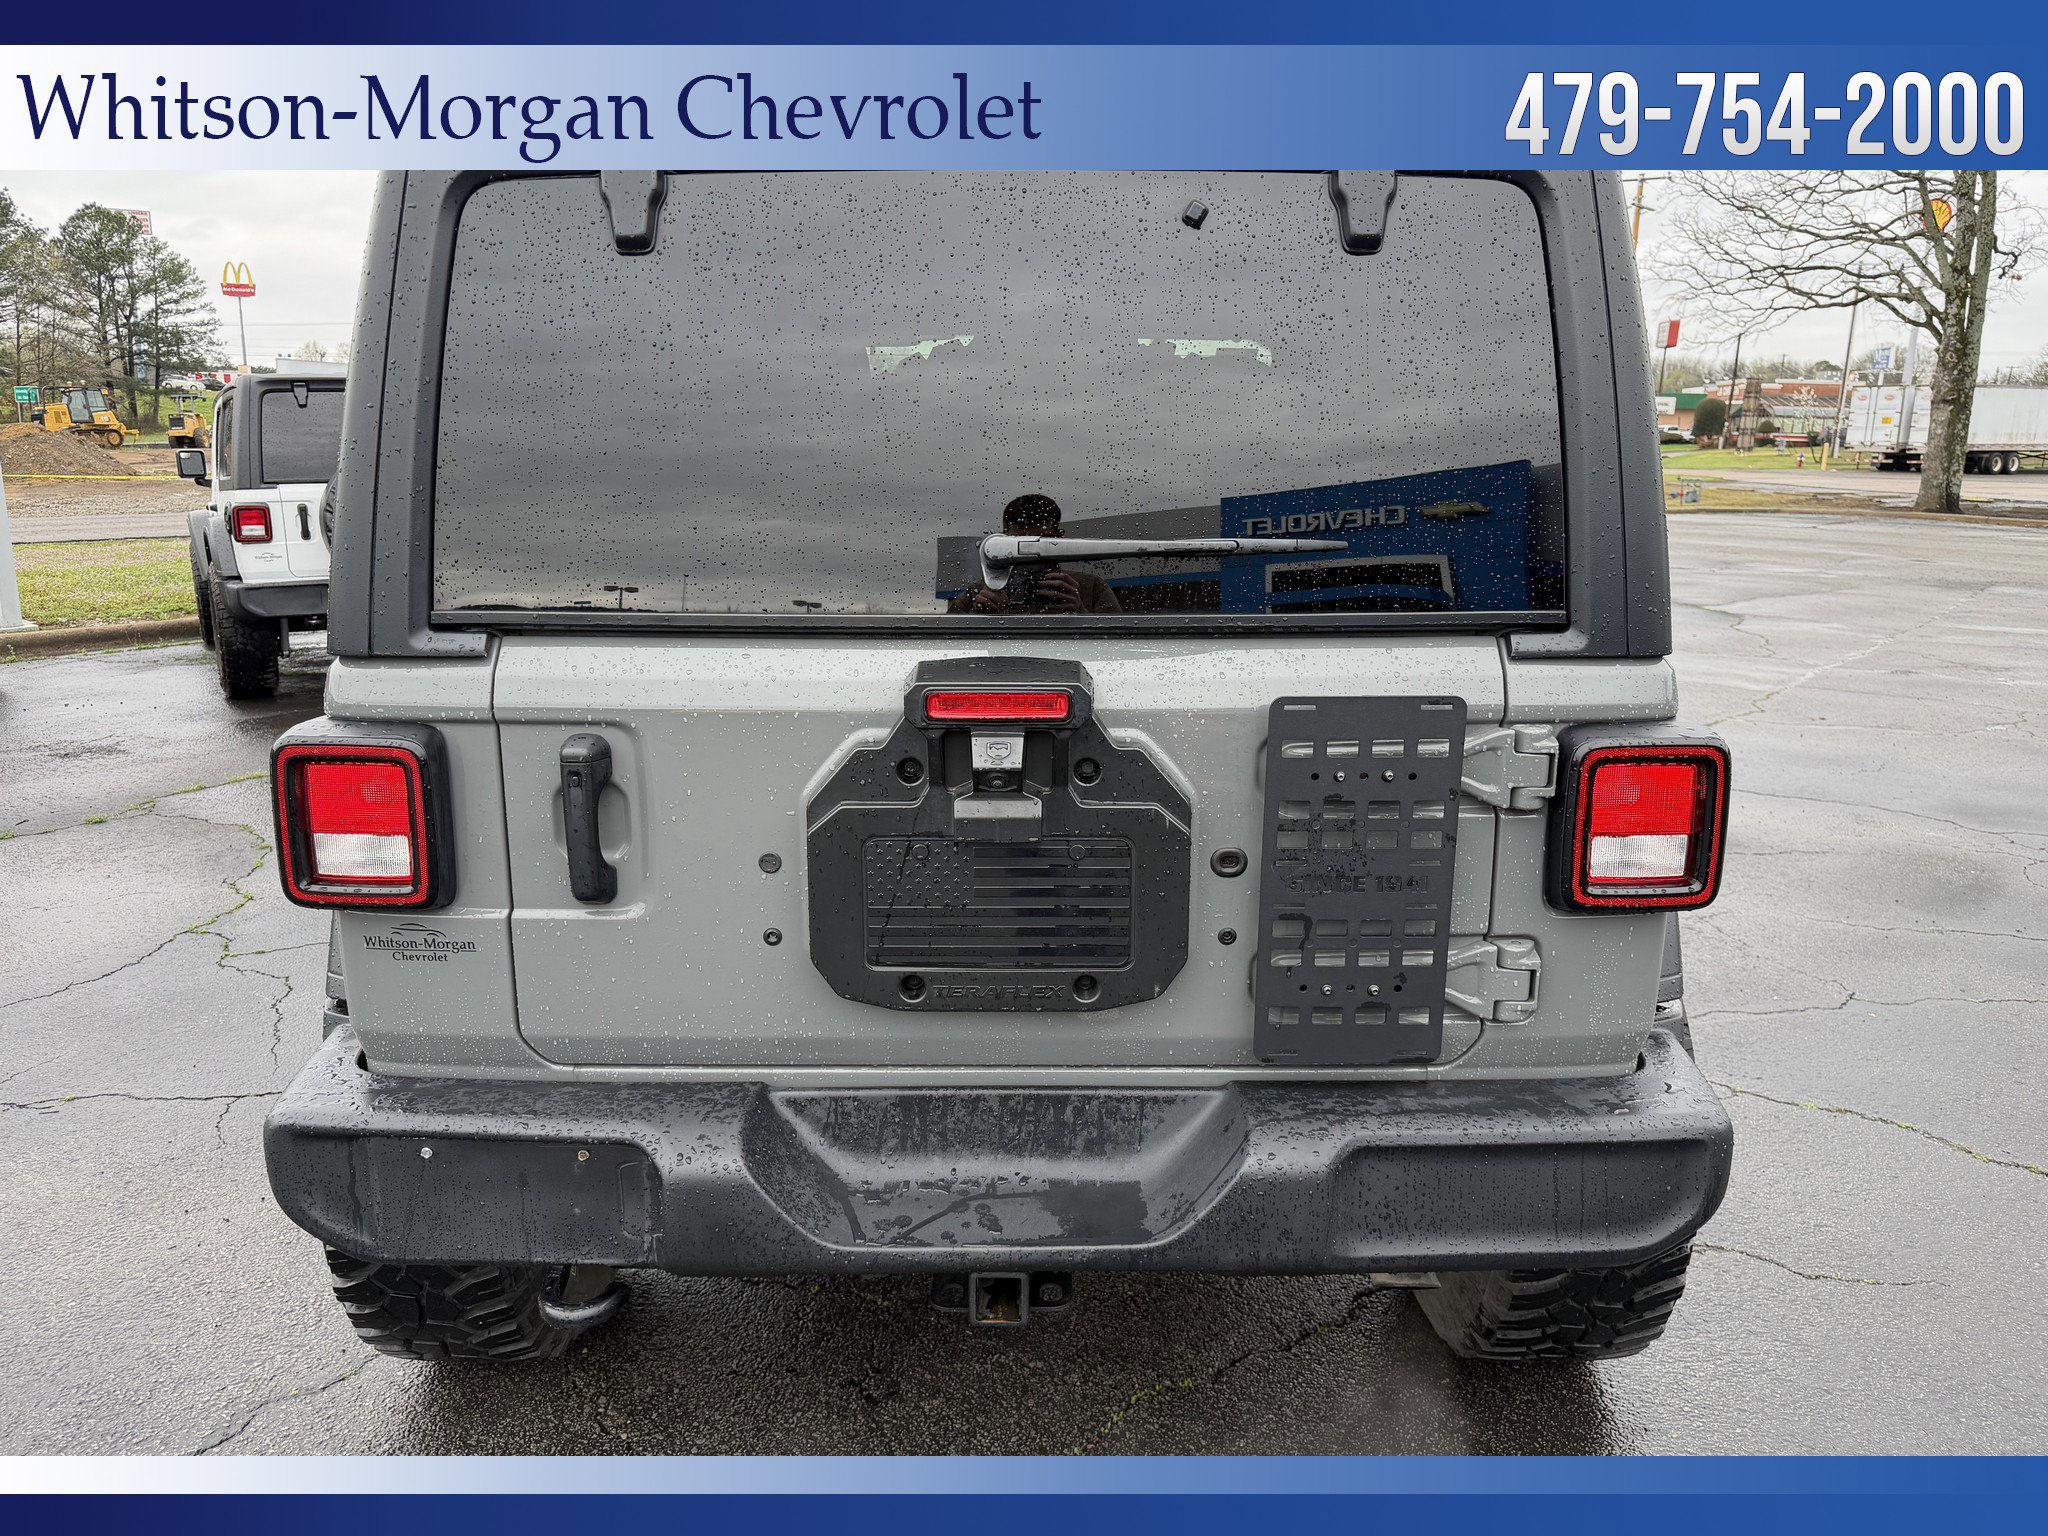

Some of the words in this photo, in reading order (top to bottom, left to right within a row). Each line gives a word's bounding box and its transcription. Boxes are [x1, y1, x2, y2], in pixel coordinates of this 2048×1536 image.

[1289, 876, 1366, 893] SINCE
[1375, 876, 1429, 893] 1941
[364, 935, 476, 954] Whitson-Morgan
[393, 951, 449, 962] Chevrolet
[933, 985, 1066, 998] TERAFLEX
